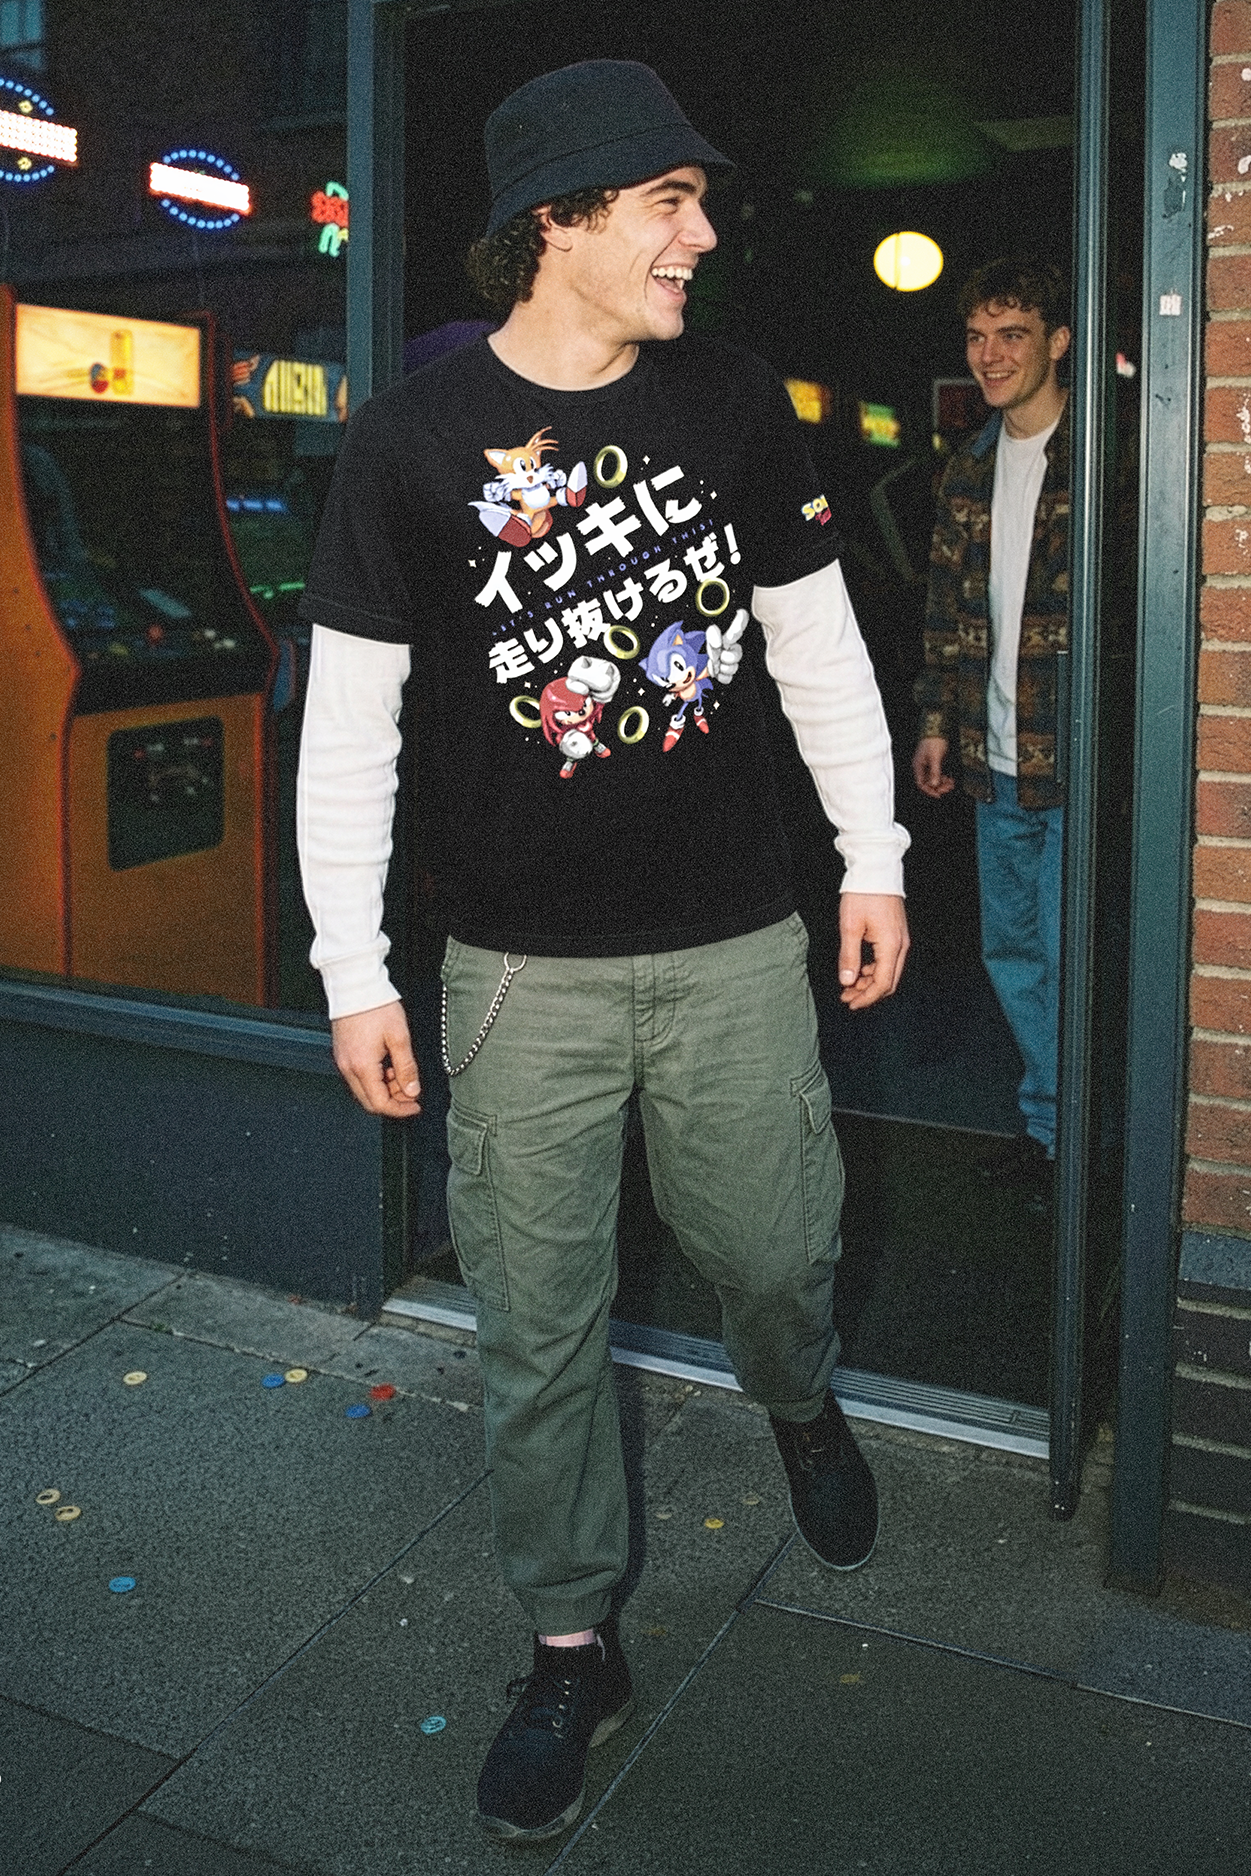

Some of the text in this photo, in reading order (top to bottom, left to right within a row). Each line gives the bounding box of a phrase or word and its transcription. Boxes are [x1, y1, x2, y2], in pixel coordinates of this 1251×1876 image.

[474, 465, 702, 614] イッキに
[544, 589, 577, 610] RUN
[586, 545, 662, 588] THROUGH
